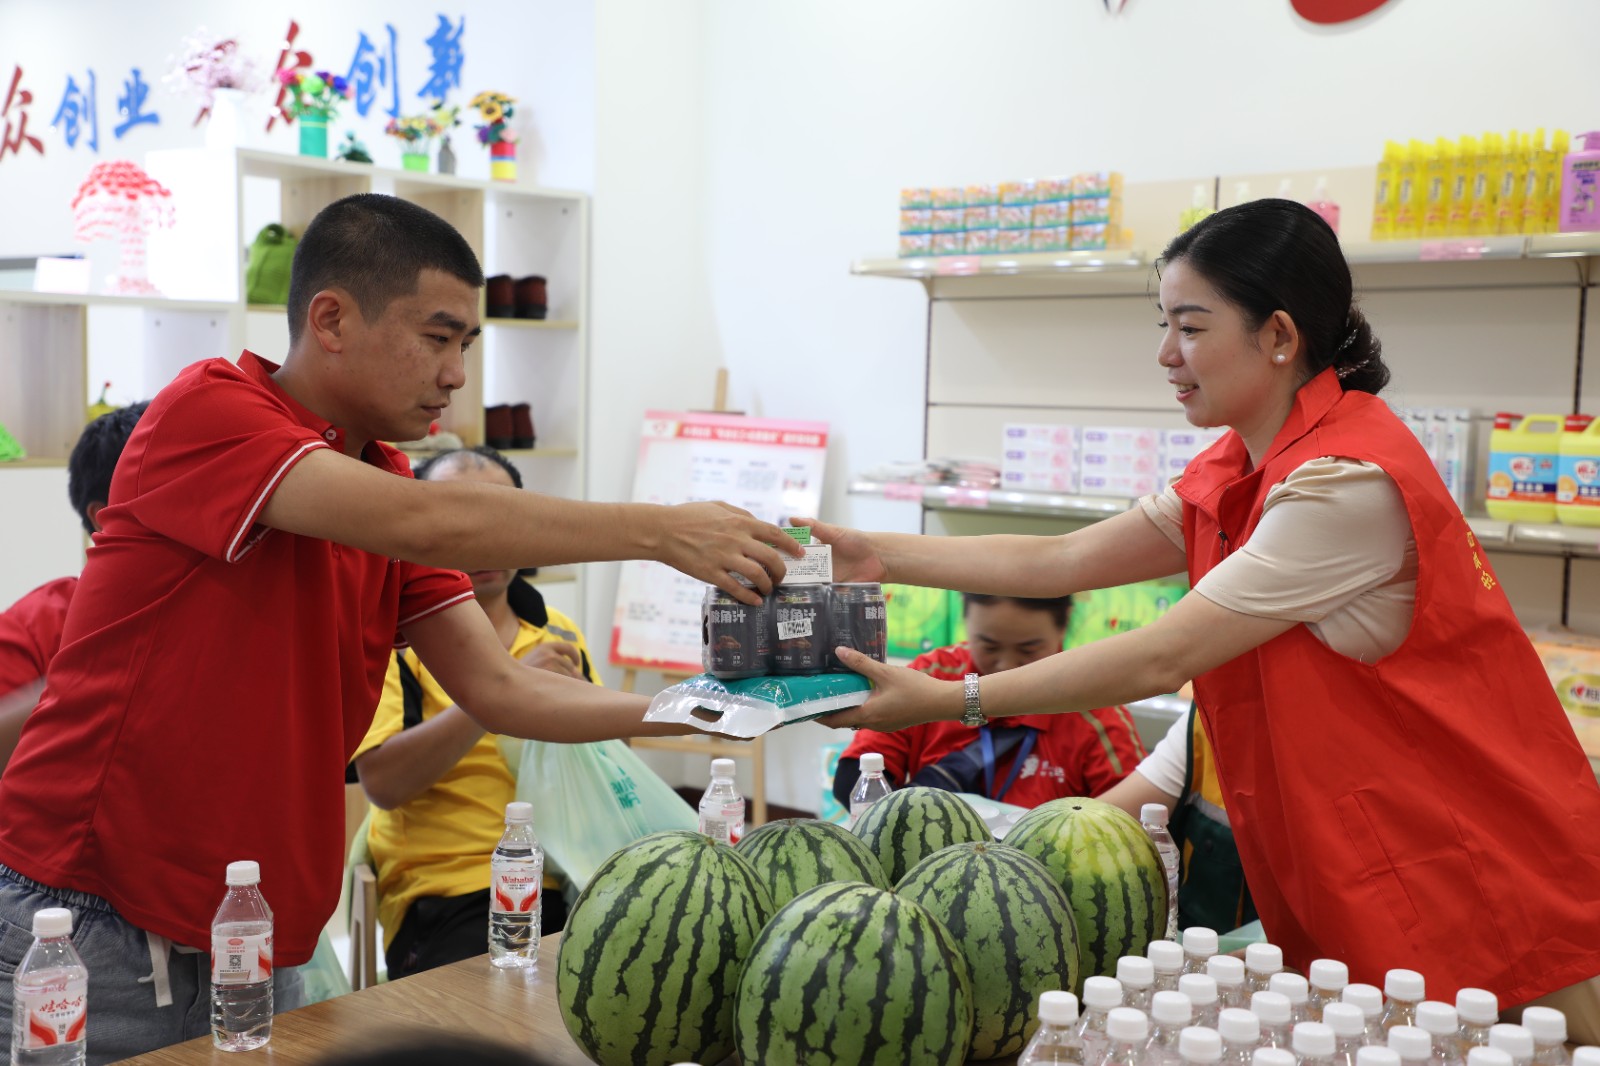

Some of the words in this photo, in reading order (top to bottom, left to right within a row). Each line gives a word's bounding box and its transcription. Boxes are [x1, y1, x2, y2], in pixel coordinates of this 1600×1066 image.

[710, 609, 747, 624] 酸角汁
[776, 607, 817, 622] 酸角汁
